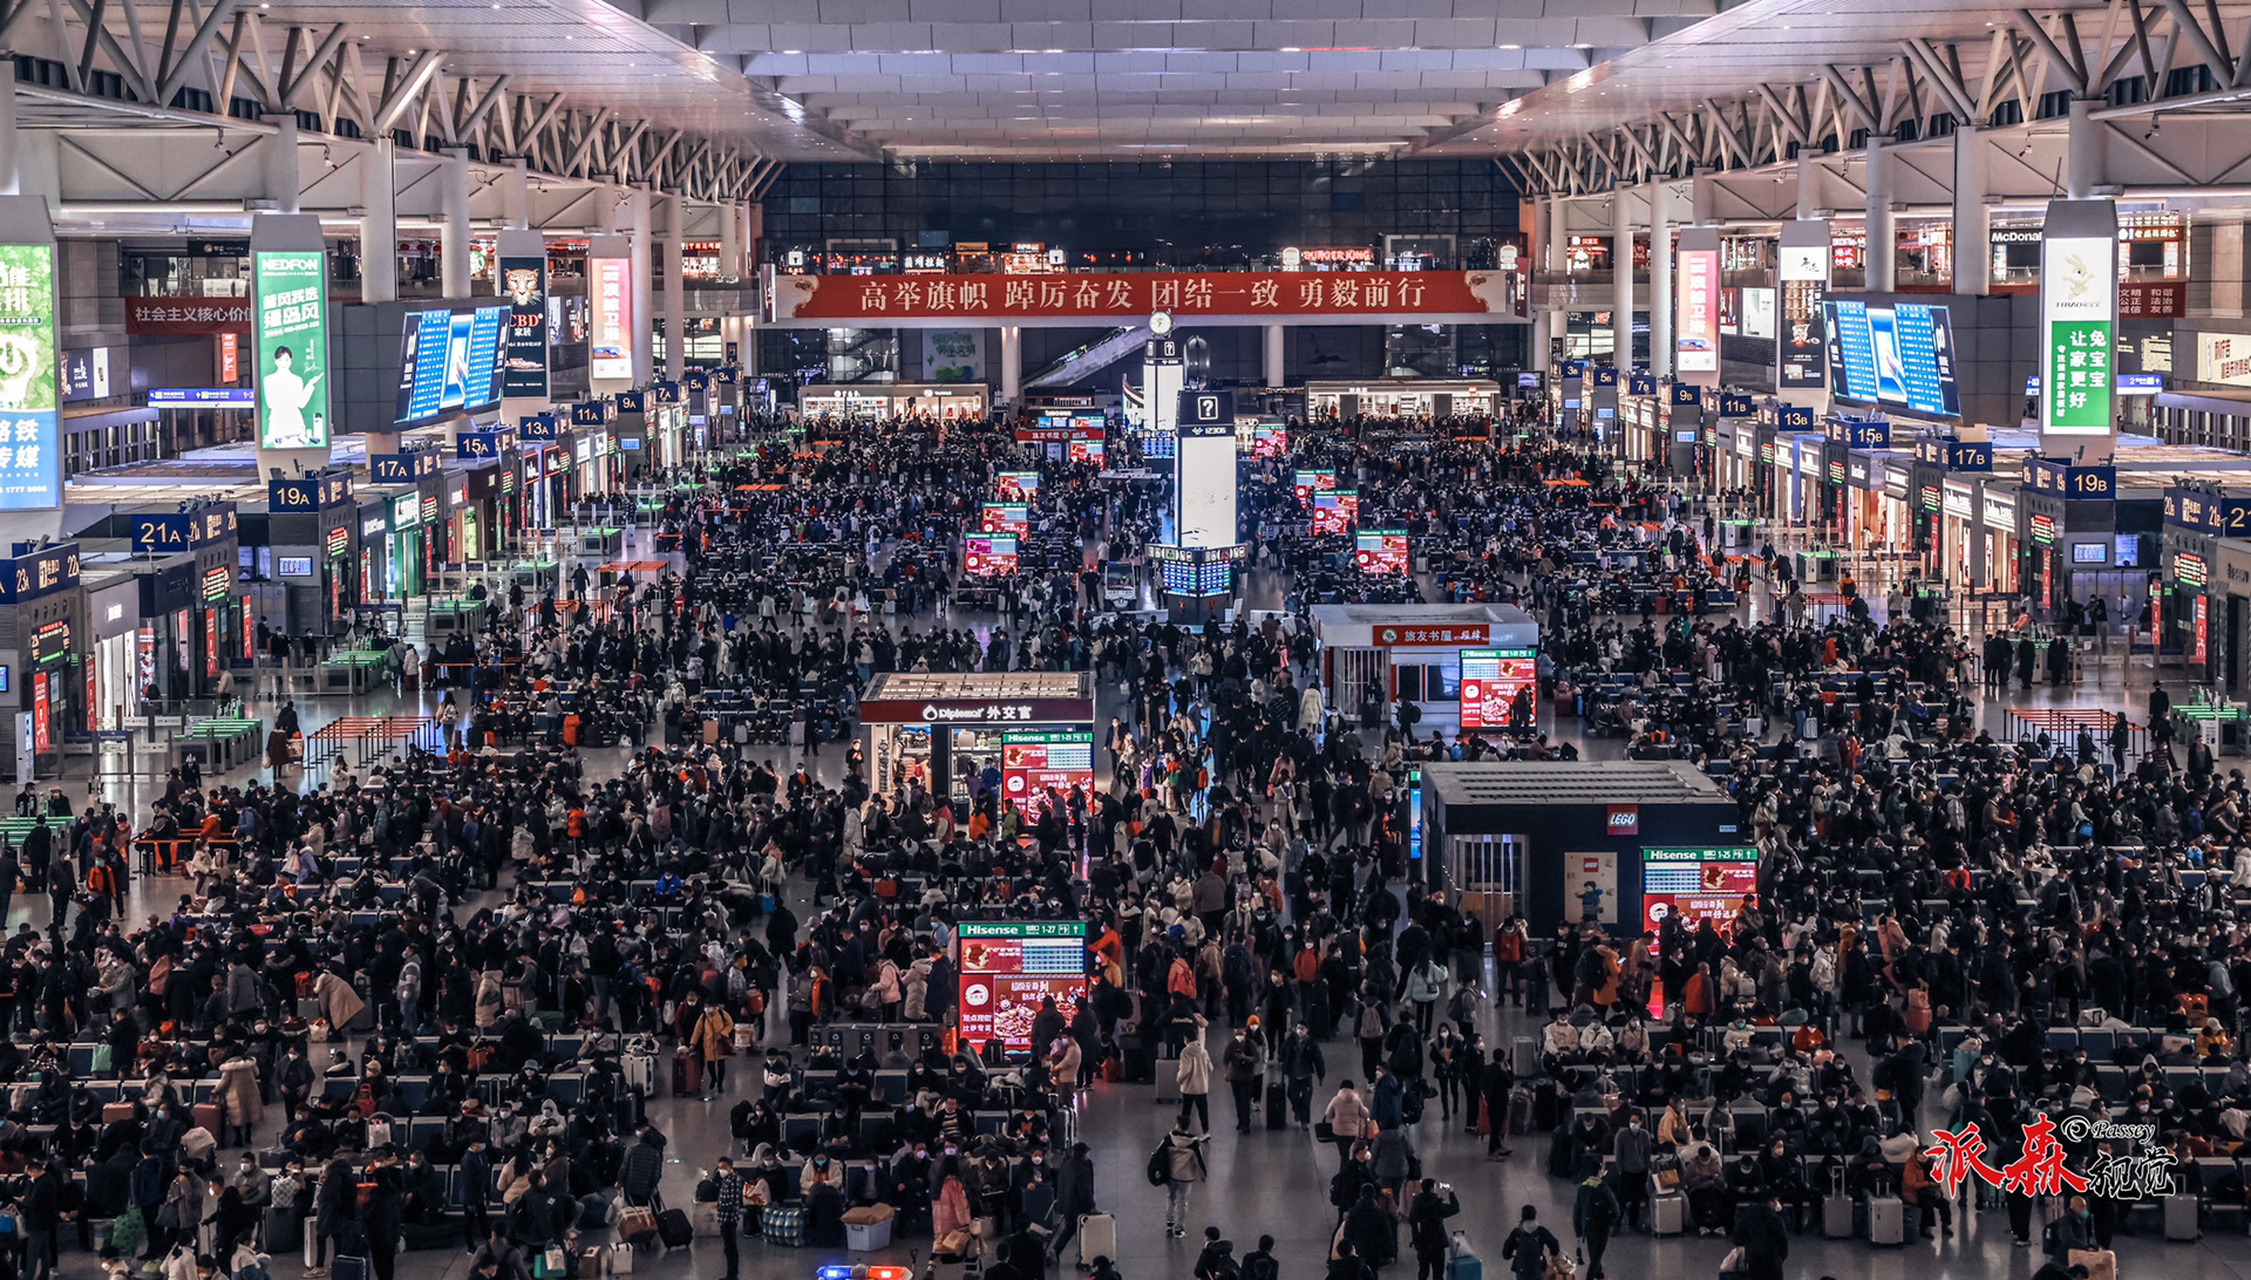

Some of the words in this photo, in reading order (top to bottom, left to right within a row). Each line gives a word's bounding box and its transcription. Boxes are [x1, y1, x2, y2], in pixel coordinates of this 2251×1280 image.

[1303, 250, 1343, 260] BURGER
[262, 259, 318, 271] NEDFON
[859, 281, 989, 311] 高举旗帜
[1004, 279, 1133, 310] 踔厉奋发
[1150, 278, 1280, 309] 团结一致
[1299, 277, 1426, 308] 勇毅前行
[2089, 329, 2107, 388] 兔宝宝
[2069, 330, 2087, 408] 让家更好
[658, 387, 671, 399] 7A
[1679, 389, 1693, 402] 9B
[623, 397, 636, 408] 9A
[1725, 400, 1747, 412] 11B
[577, 408, 598, 421] 11A
[1784, 413, 1808, 426] 13B
[526, 421, 549, 435] 13A
[1857, 428, 1883, 443] 15B
[463, 438, 488, 453] 15A
[1956, 449, 1986, 465] 17B
[377, 460, 408, 477] 17A
[2074, 474, 2108, 492] 19B
[277, 487, 310, 505] 19A
[140, 522, 182, 543] 21A
[1404, 630, 1452, 642] 旅友书屋
[986, 705, 1032, 720] 外交官
[1008, 734, 1045, 742] Hisense
[1610, 813, 1636, 826] LEGO
[1650, 850, 1697, 859] Hisense
[967, 925, 1019, 935] Hisense
[1042, 925, 1056, 934] 1-27
